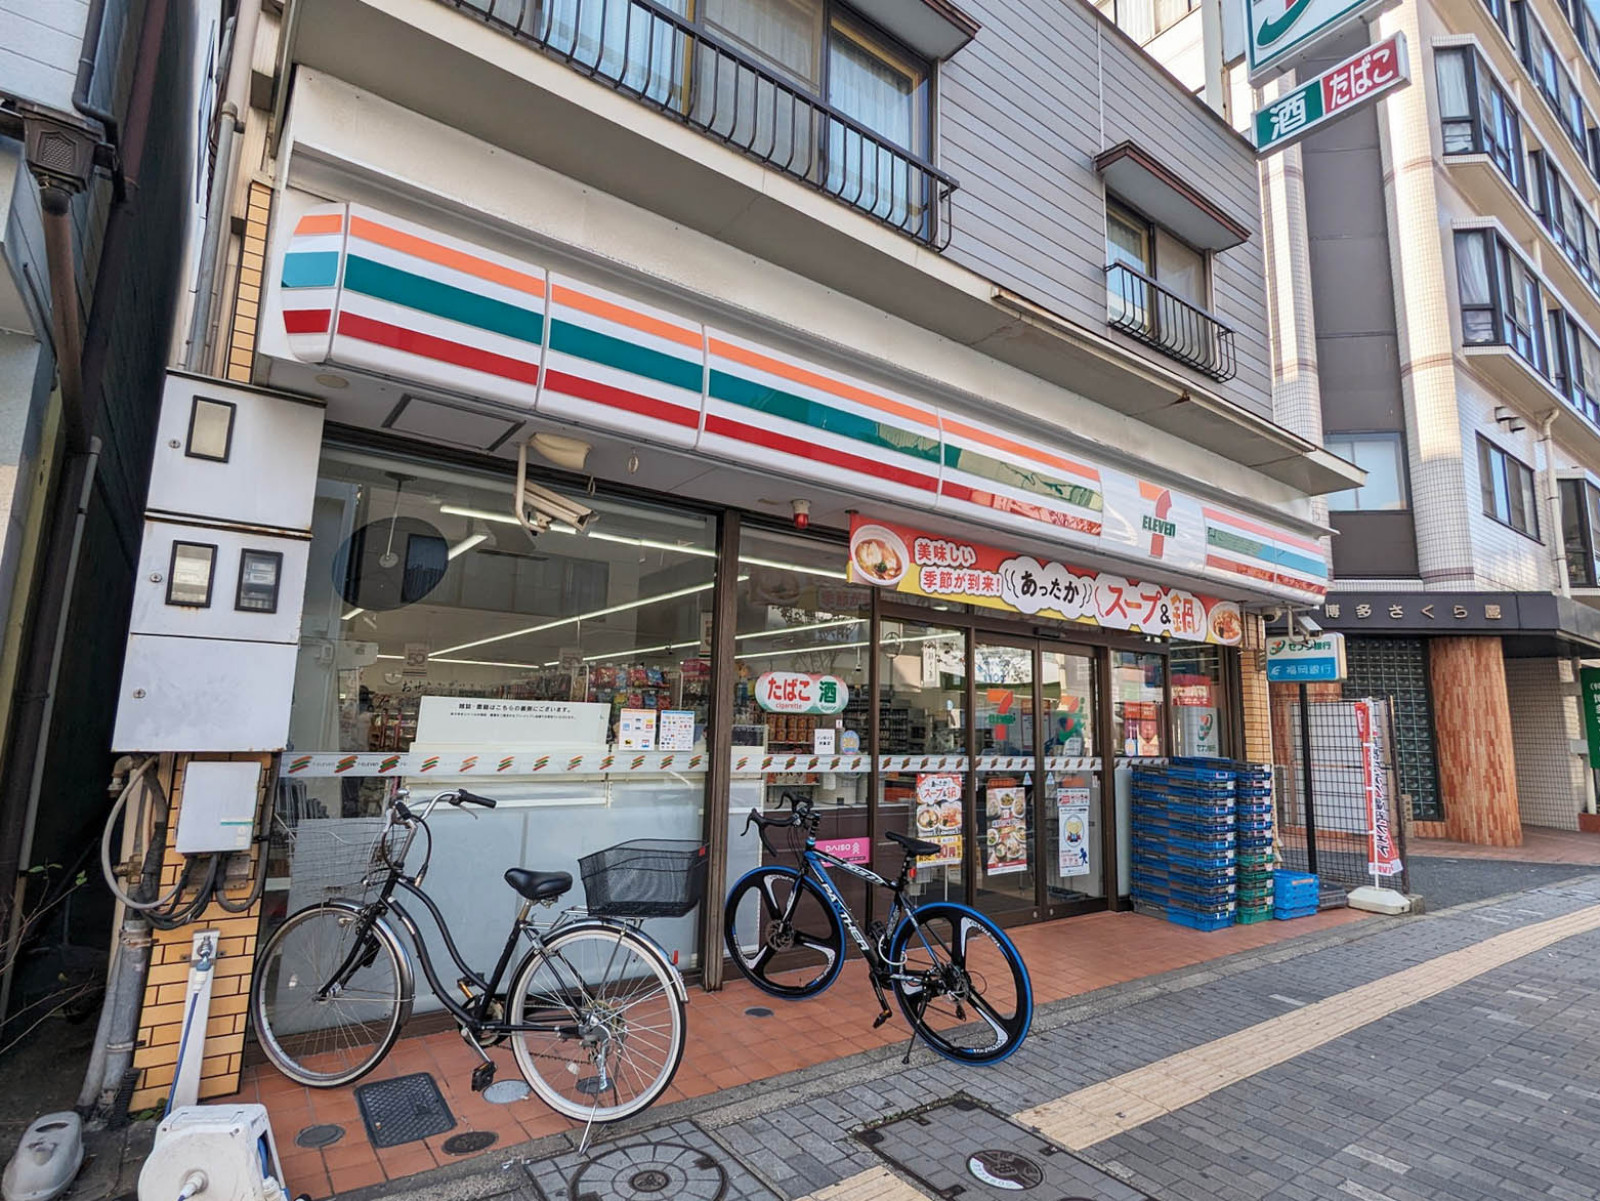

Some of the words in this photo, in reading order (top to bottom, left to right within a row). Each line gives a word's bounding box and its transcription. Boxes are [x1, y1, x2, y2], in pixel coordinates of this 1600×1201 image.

[1270, 91, 1306, 141] 酒
[1329, 48, 1393, 109] たばこ
[917, 542, 975, 565] 美味しい
[923, 569, 1000, 594] 季節が到来!
[1021, 569, 1079, 604] あったか
[1286, 664, 1332, 676] 福岡銀行
[768, 677, 811, 702] たばこ
[819, 680, 837, 703] 酒
[825, 844, 850, 852] DAISO
